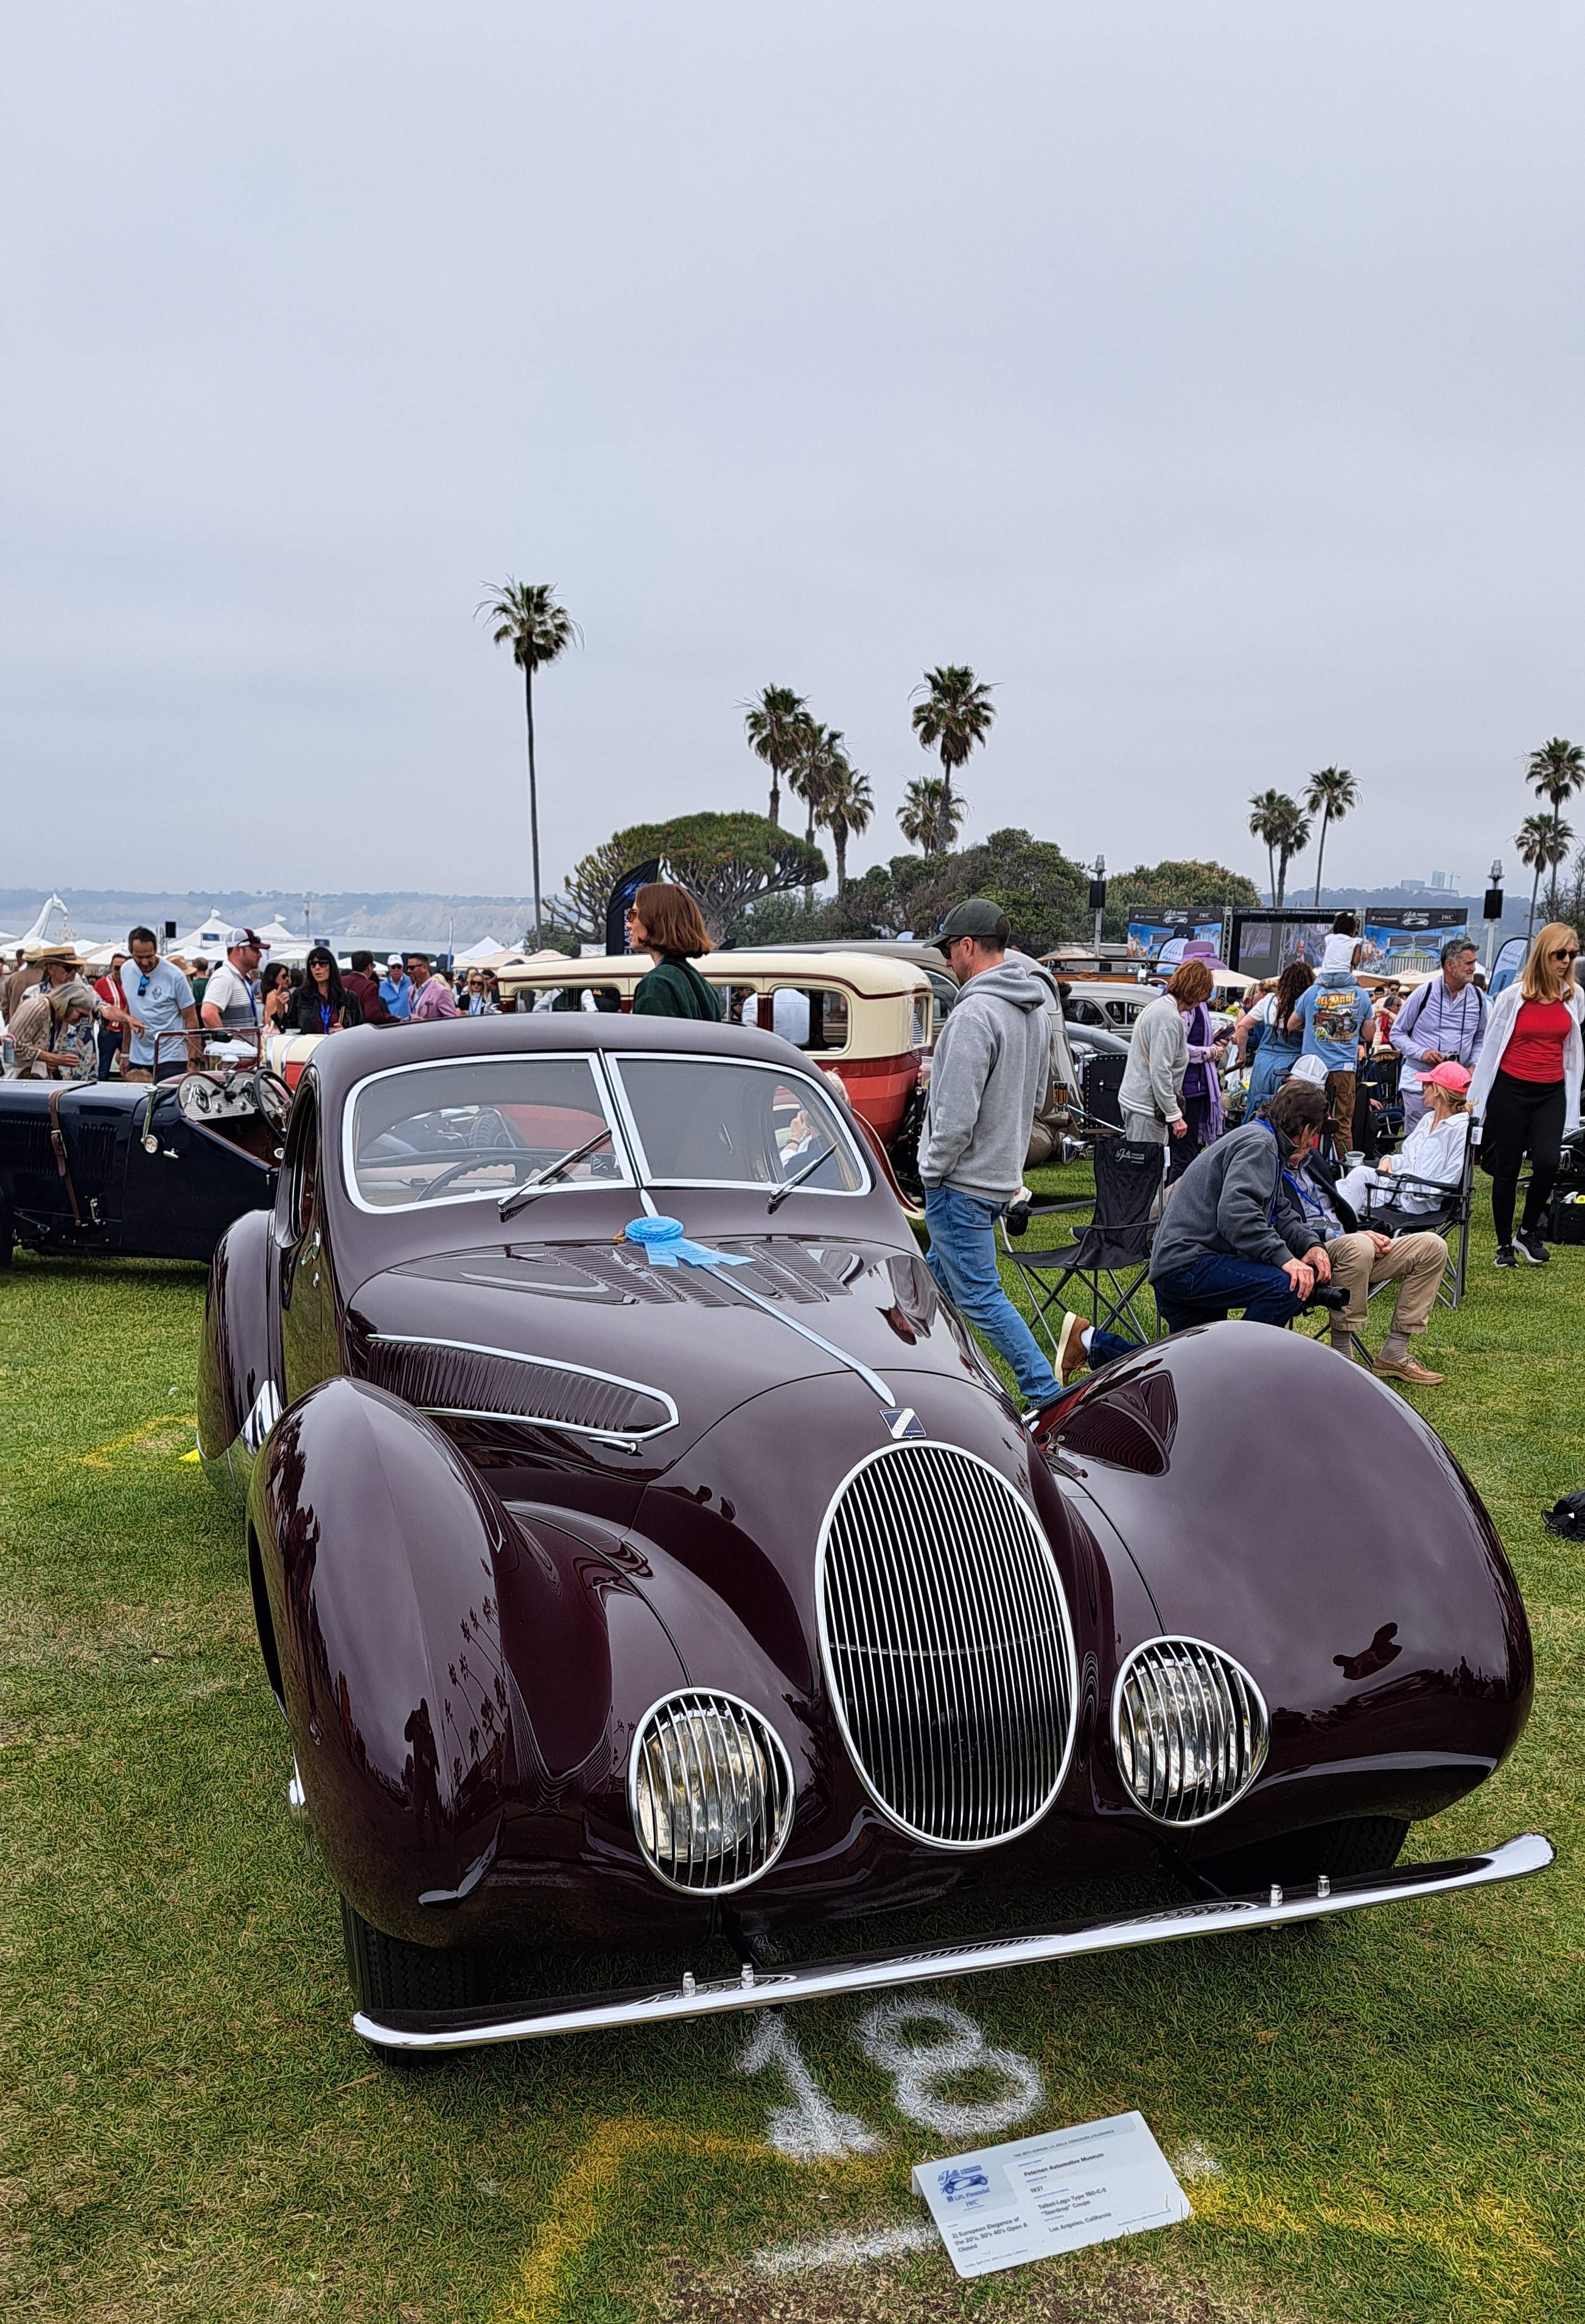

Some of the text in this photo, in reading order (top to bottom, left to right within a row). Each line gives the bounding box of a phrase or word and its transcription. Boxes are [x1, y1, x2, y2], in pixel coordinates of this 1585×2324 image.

[894, 1410, 912, 1432] TALBOT
[735, 2000, 1047, 2162] 18
[1024, 2167, 1048, 2177] Petersen
[1049, 2158, 1080, 2170] Automotive
[1081, 2152, 1104, 2161] Museum
[966, 2187, 990, 2198] Financial
[965, 2199, 979, 2207] IWC
[1037, 2197, 1070, 2210] Talbot-Lago
[1070, 2193, 1085, 2202] Type
[1072, 2200, 1091, 2210] Coupe
[958, 2225, 987, 2238] European
[986, 2219, 1013, 2230] Elegance
[1006, 2224, 1023, 2233] Open
[1060, 2219, 1085, 2231] Angeles,
[1085, 2211, 1112, 2223] California
[957, 2243, 978, 2253] Closed
